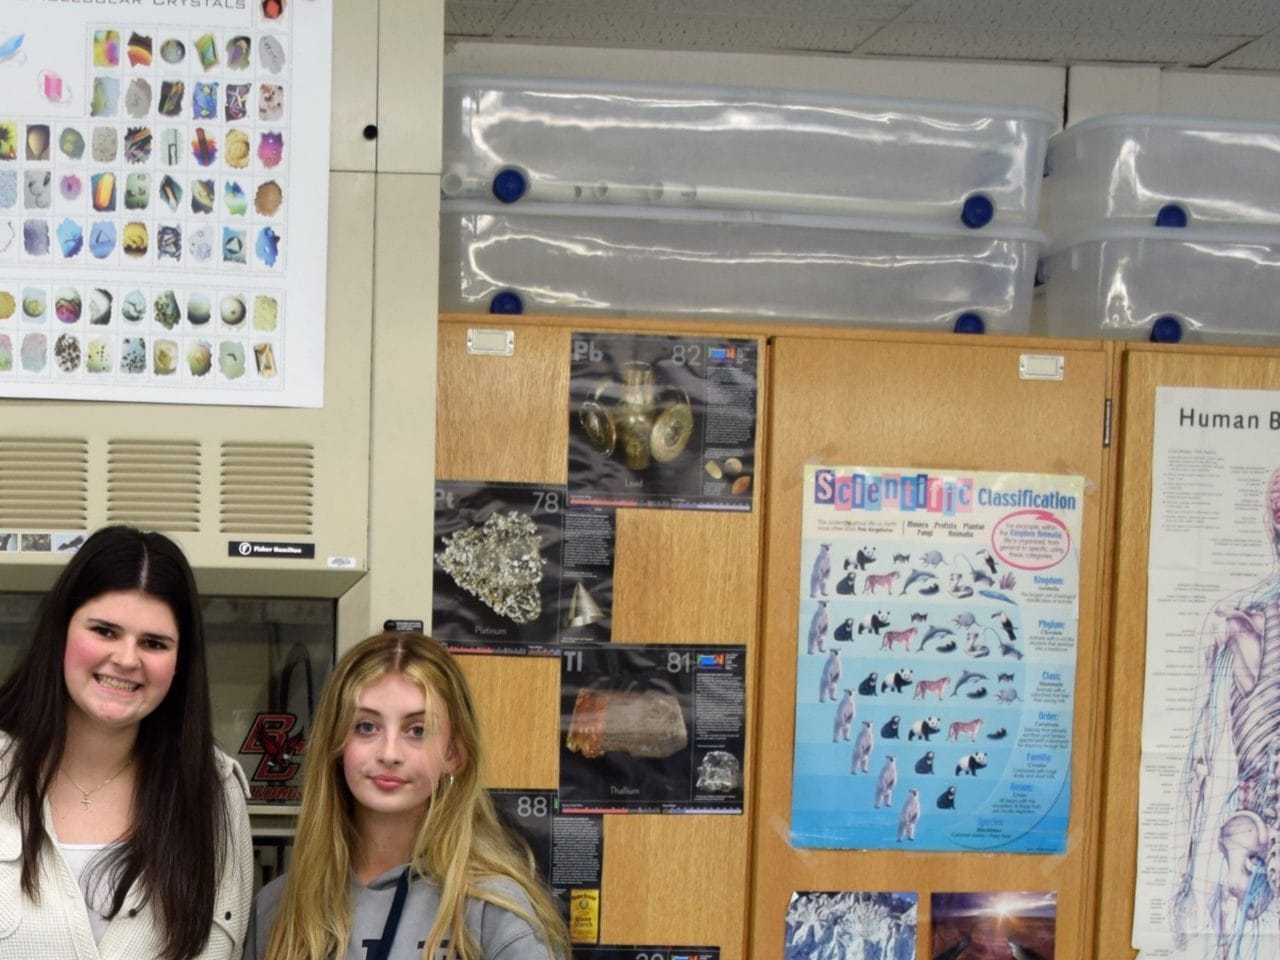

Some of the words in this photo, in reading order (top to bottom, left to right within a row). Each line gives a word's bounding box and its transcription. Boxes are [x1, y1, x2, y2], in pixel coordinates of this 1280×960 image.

[574, 341, 603, 362] Pb
[671, 344, 701, 366] 82
[1179, 407, 1260, 429] Human
[816, 470, 972, 513] Scientific
[977, 487, 1077, 510] Classification
[532, 492, 560, 514] 78
[474, 625, 507, 635] Platinum
[667, 651, 690, 673] 81
[517, 796, 547, 817] 88
